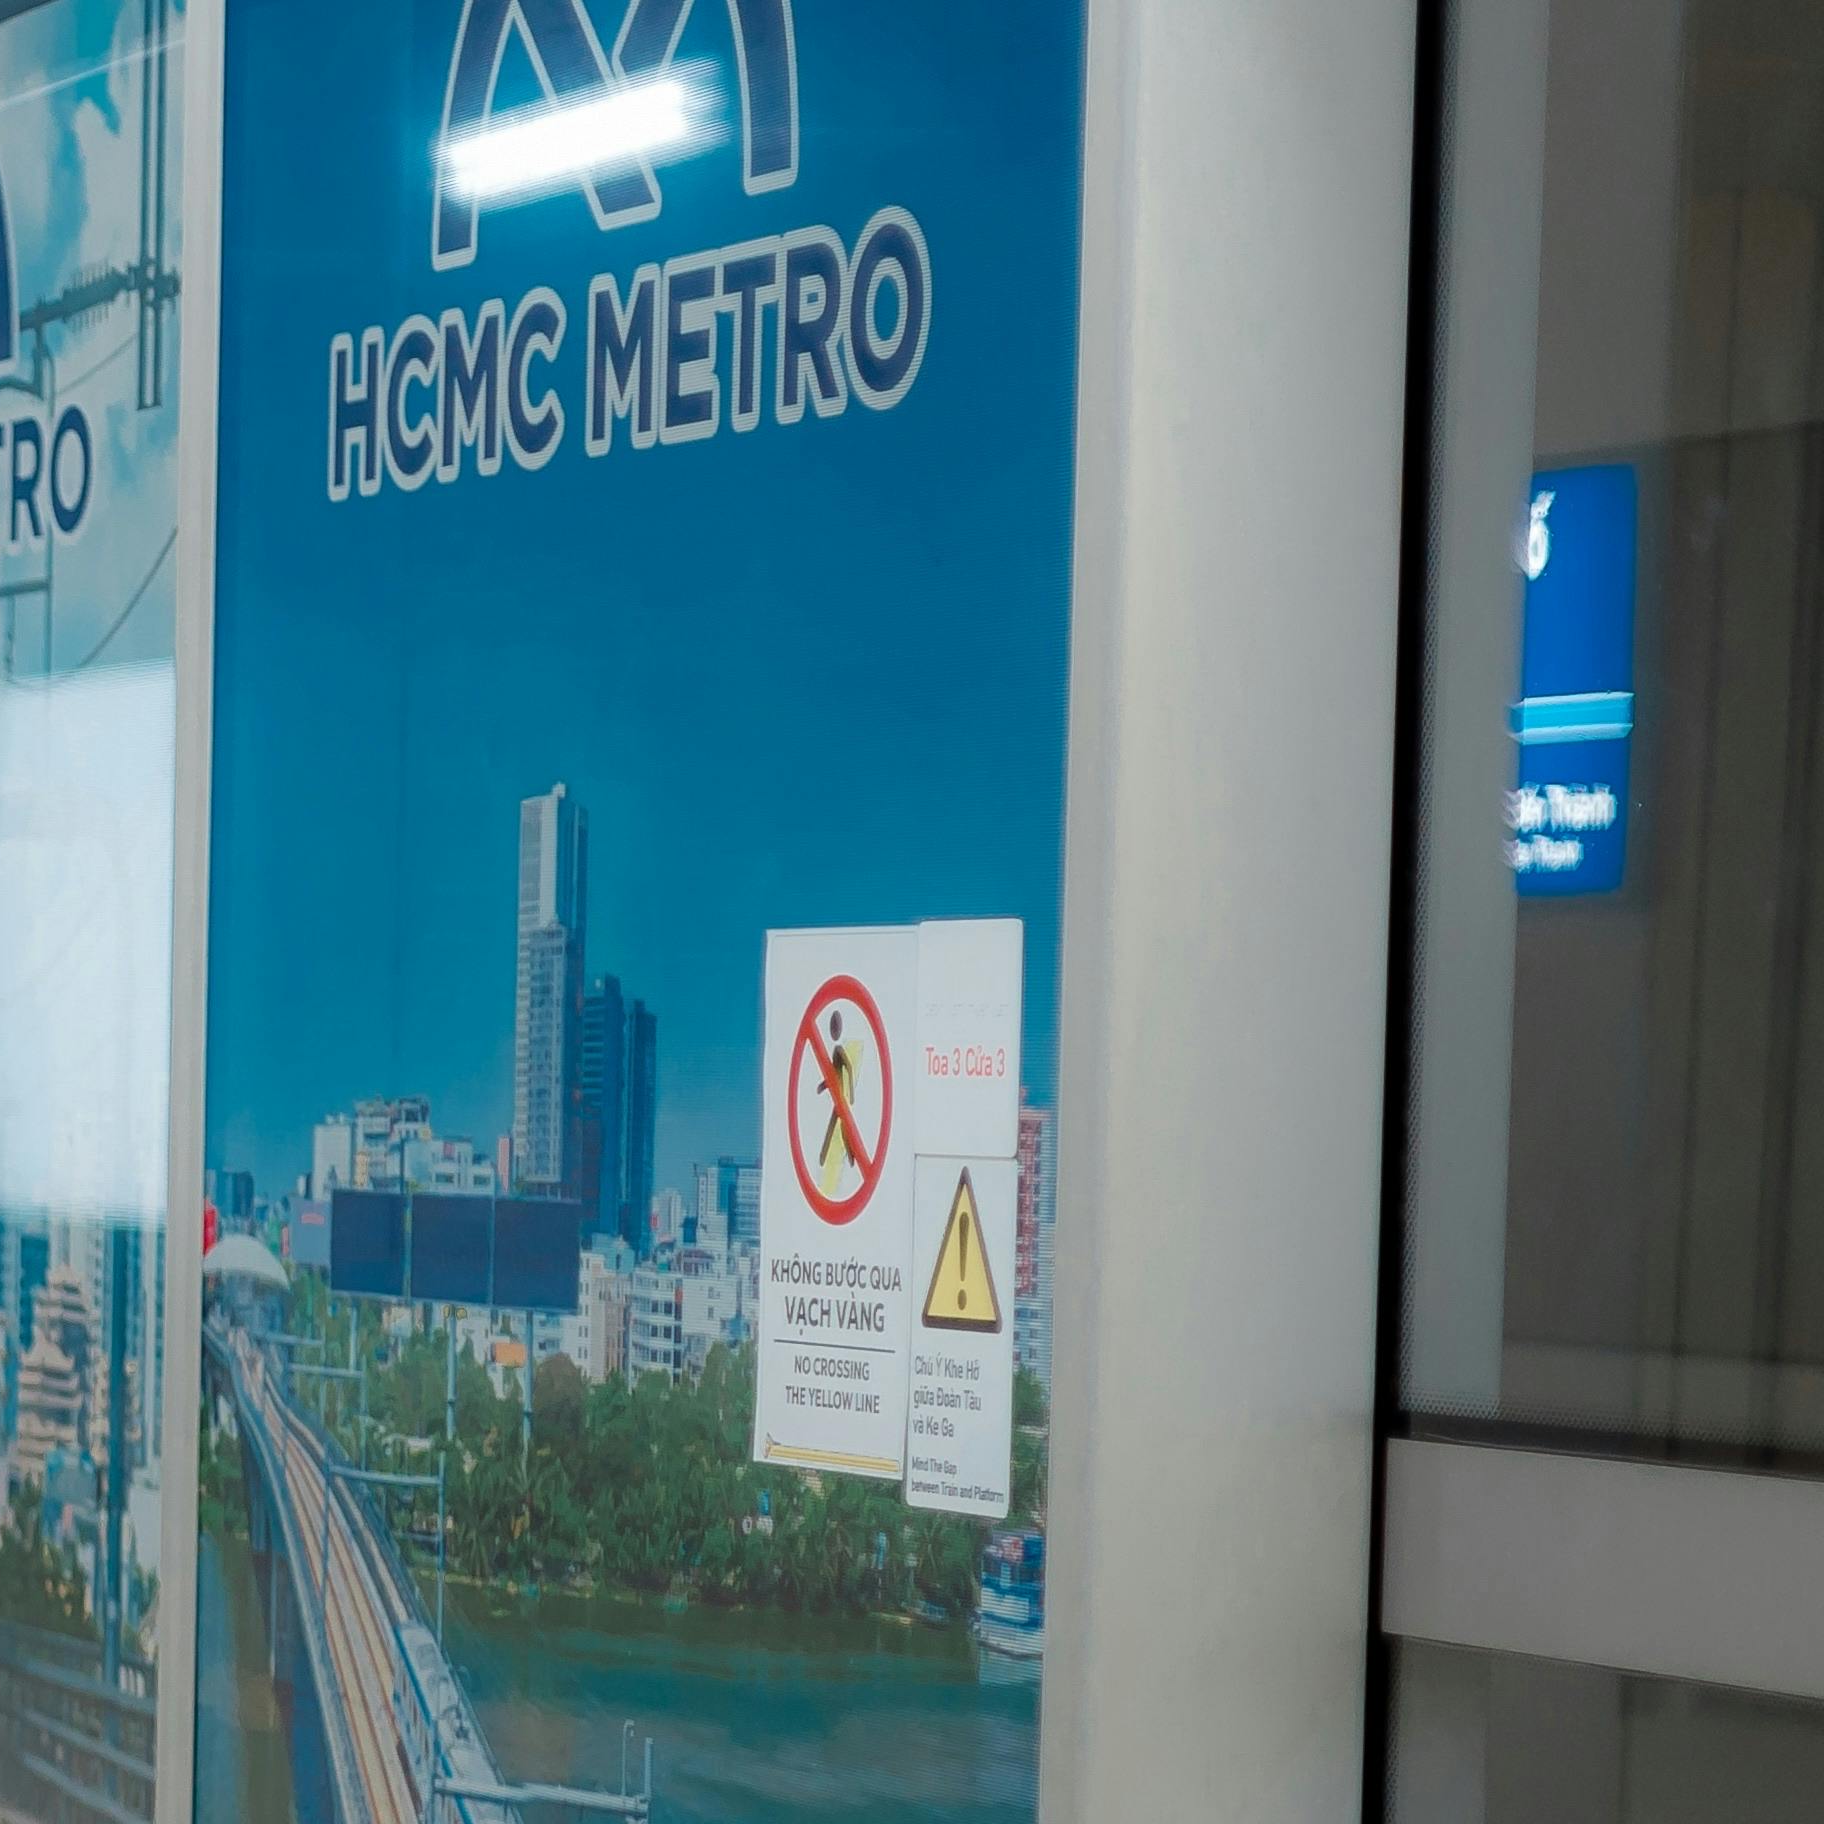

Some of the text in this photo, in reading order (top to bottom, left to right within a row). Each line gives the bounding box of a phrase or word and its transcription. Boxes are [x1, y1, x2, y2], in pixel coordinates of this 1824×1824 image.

[328, 205, 931, 501] HCMC METRO
[925, 1044, 1005, 1077] Toa 3 Cửa 3
[771, 1252, 902, 1292] KHÔNG BƯỚC QUA
[785, 1291, 885, 1336] VẠCH VÀNG
[794, 1356, 870, 1381] NO CROSSING
[914, 1356, 934, 1376] Chú
[935, 1352, 943, 1377] Ý
[944, 1358, 963, 1380] Khe
[786, 1385, 880, 1414] THE YELLOW LINE
[912, 1414, 954, 1438] và Ke Ga
[911, 1455, 958, 1480] Mind The Gap
[941, 1481, 959, 1497] Train
[959, 1486, 973, 1500] and
